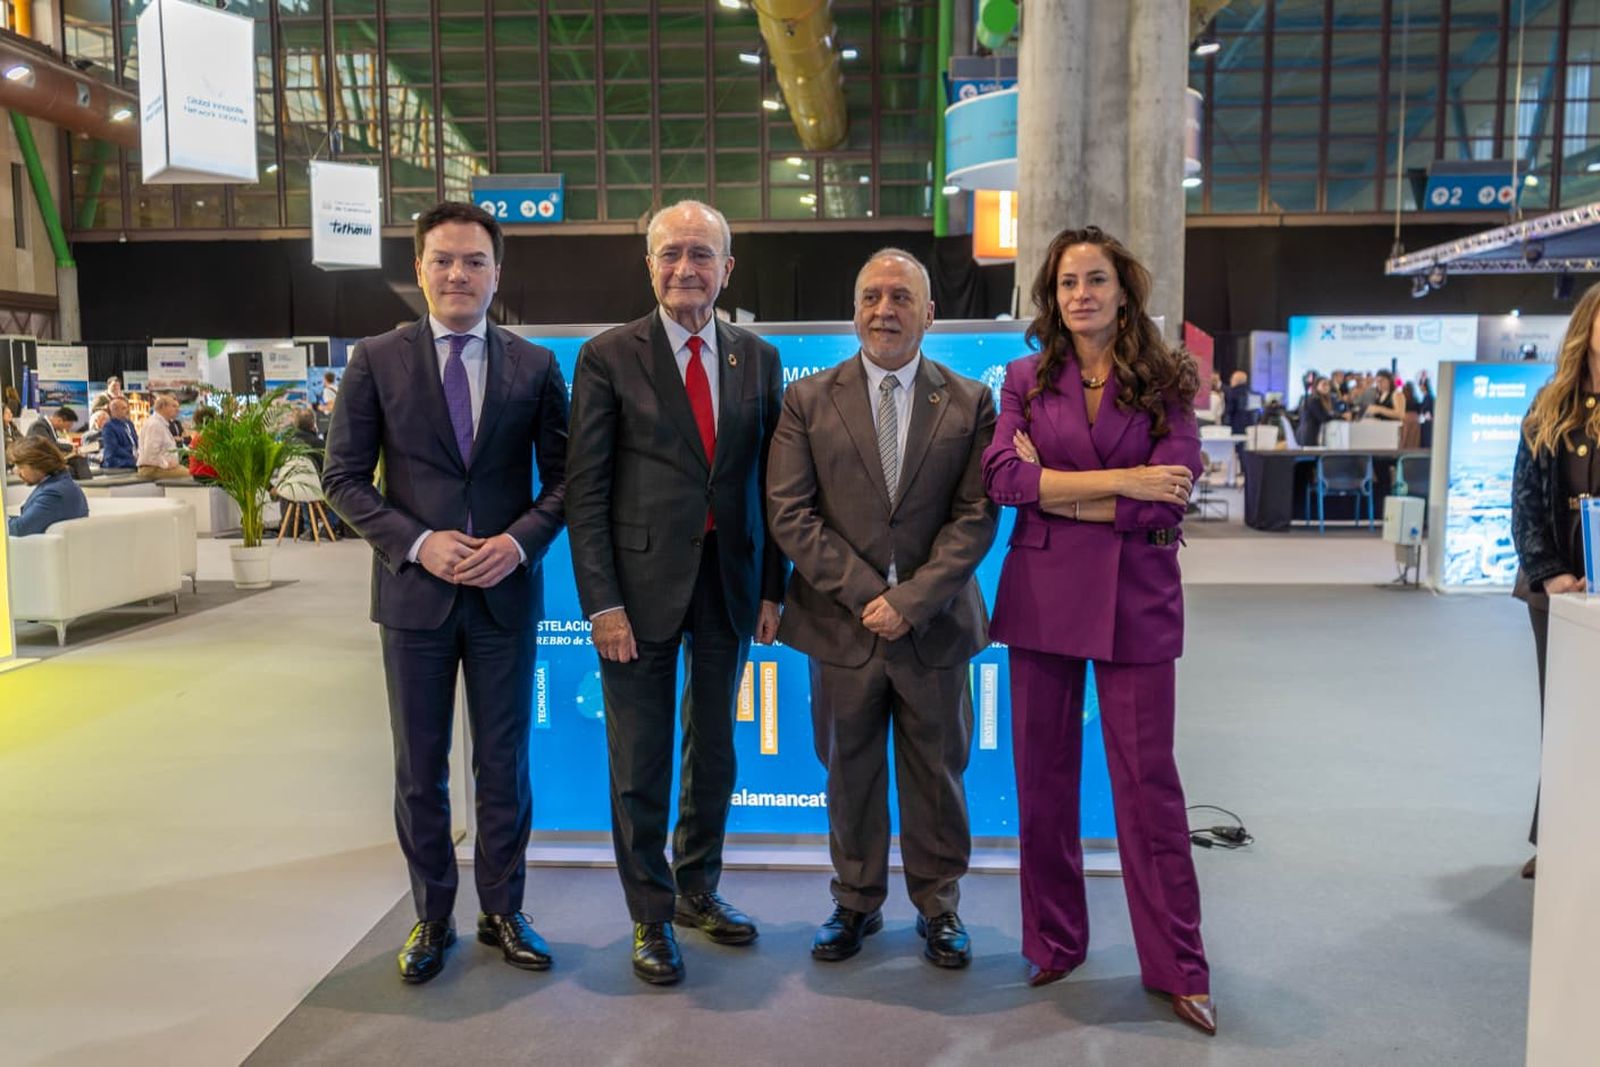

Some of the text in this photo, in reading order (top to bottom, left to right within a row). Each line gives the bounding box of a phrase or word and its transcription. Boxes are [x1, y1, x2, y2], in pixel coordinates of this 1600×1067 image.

[1450, 187, 1463, 205] 2
[497, 200, 508, 218] 2
[573, 636, 583, 645] de
[534, 668, 546, 724] TECNOLOGÍA
[731, 788, 827, 807] alamancat
